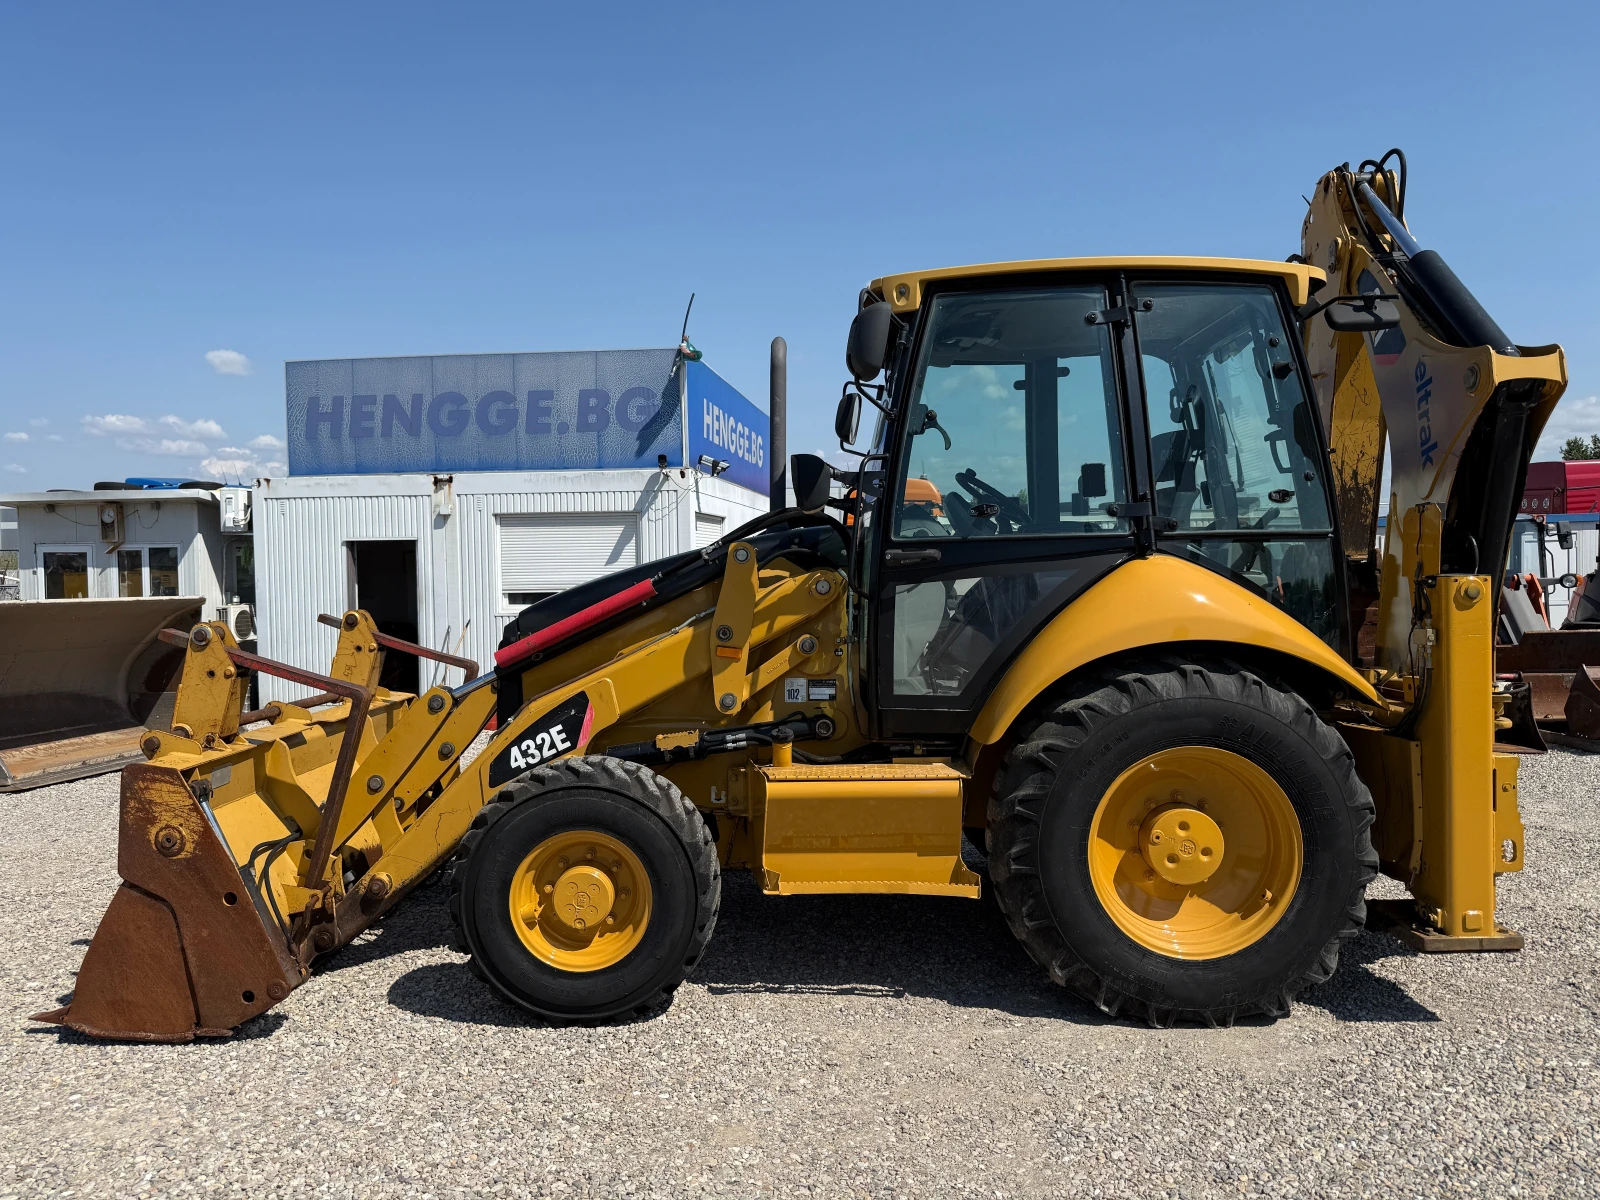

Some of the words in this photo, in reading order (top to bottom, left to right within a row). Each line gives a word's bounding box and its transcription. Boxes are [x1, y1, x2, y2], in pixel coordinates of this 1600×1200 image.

[304, 386, 661, 440] HENGGE.BG
[703, 397, 764, 468] HENGGE.BG
[1415, 360, 1438, 471] eltrak
[786, 688, 800, 700] 102
[510, 724, 571, 769] 432E
[1236, 722, 1337, 823] ALLIANCE
